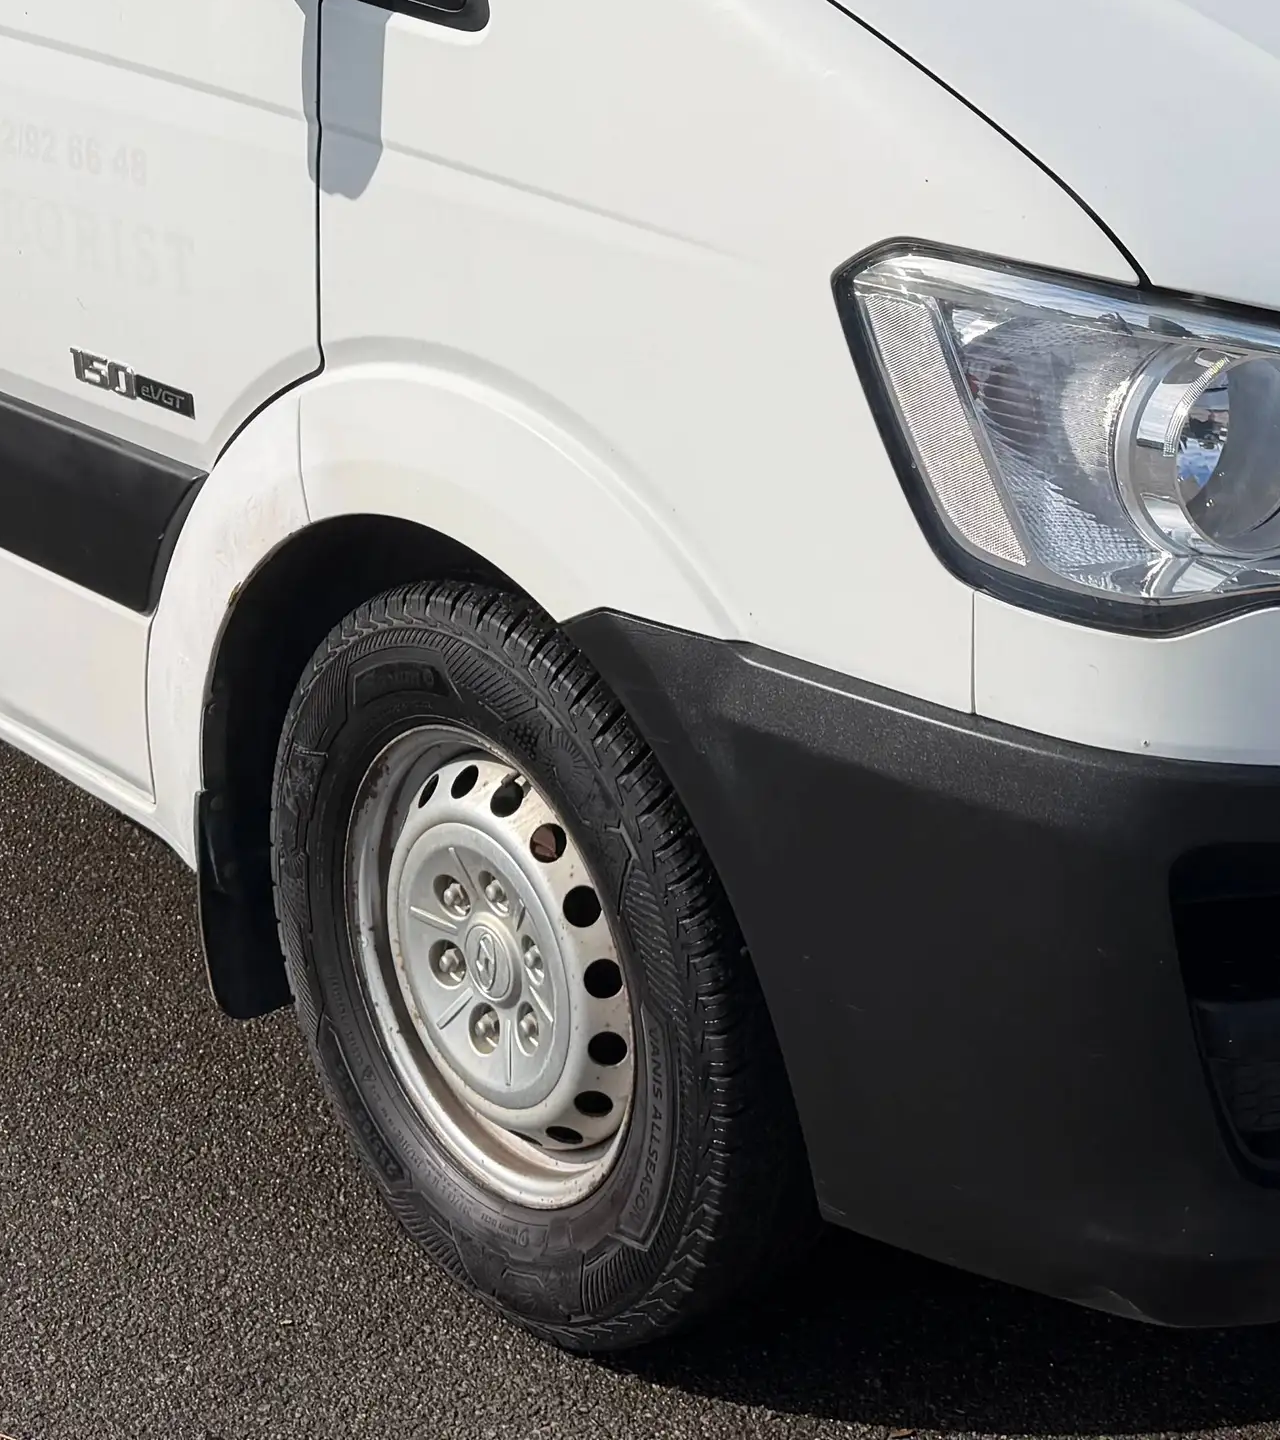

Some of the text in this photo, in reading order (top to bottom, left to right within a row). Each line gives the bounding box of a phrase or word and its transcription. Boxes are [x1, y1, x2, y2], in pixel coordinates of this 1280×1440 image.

[69, 346, 186, 410] 150 eVGT
[646, 1026, 664, 1103] VANIS
